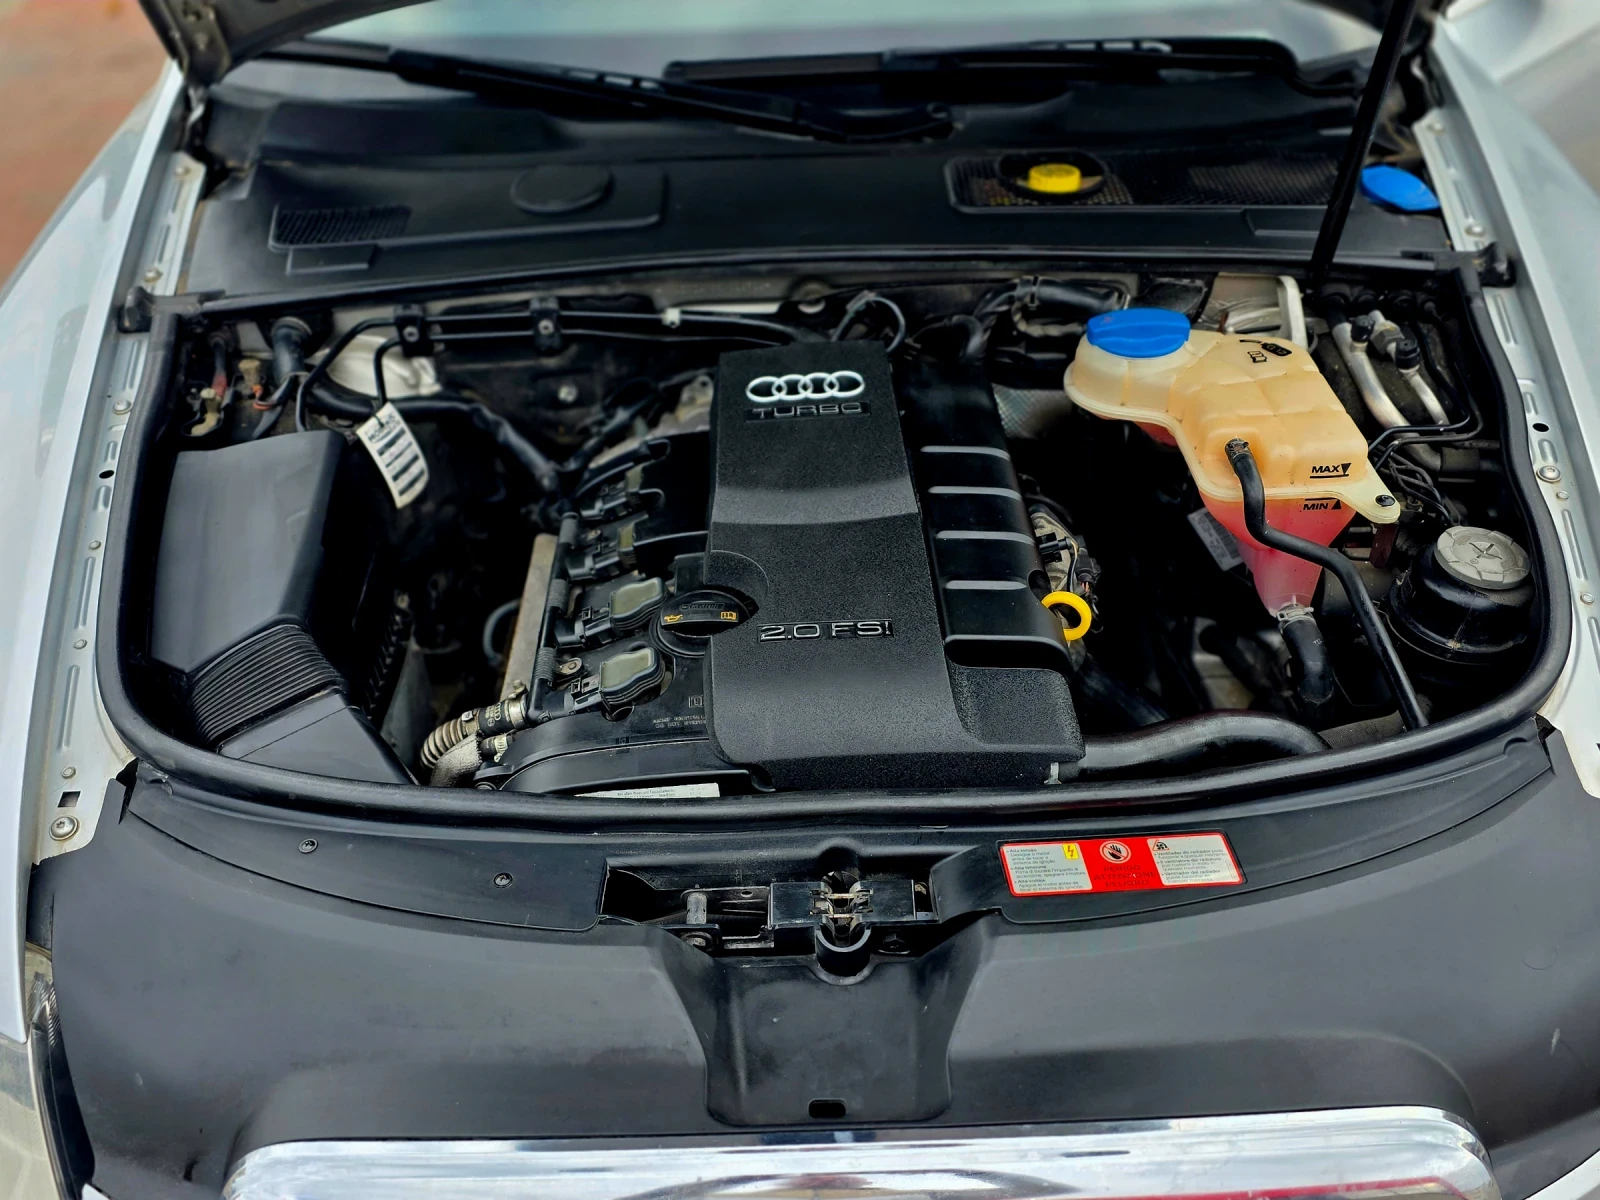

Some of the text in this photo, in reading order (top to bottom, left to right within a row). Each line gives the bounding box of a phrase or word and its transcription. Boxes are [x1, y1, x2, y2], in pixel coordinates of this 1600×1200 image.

[752, 402, 862, 419] TURBO
[1311, 464, 1340, 474] MAX
[1303, 502, 1329, 511] MIN
[760, 621, 891, 641] 2.0 FSI
